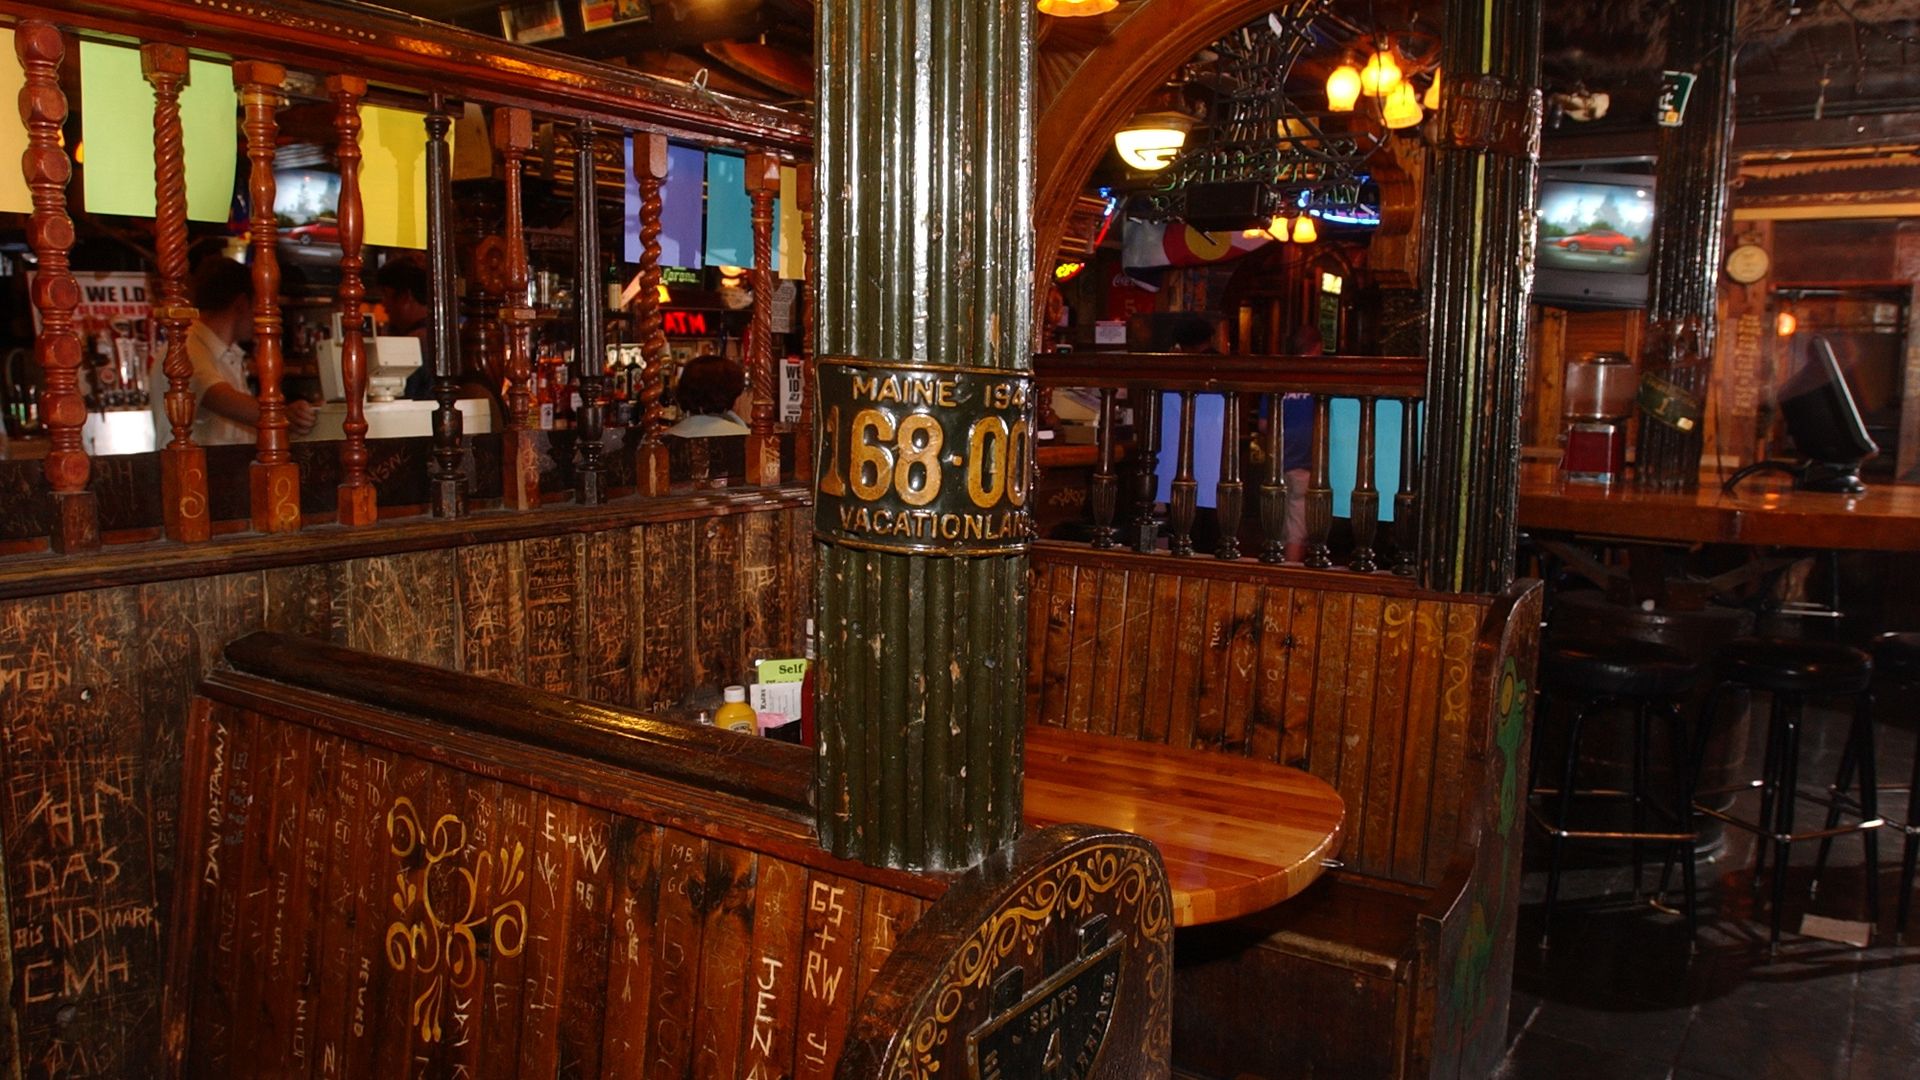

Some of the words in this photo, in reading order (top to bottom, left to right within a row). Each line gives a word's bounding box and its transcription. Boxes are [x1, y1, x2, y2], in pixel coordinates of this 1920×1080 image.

[86, 286, 117, 302] WE
[664, 311, 706, 334] ATM
[852, 374, 957, 407] MAINE
[984, 384, 1027, 410] 194
[839, 506, 1036, 540] VACATIONLAN
[778, 663, 804, 675] Self
[805, 950, 843, 1006] RW
